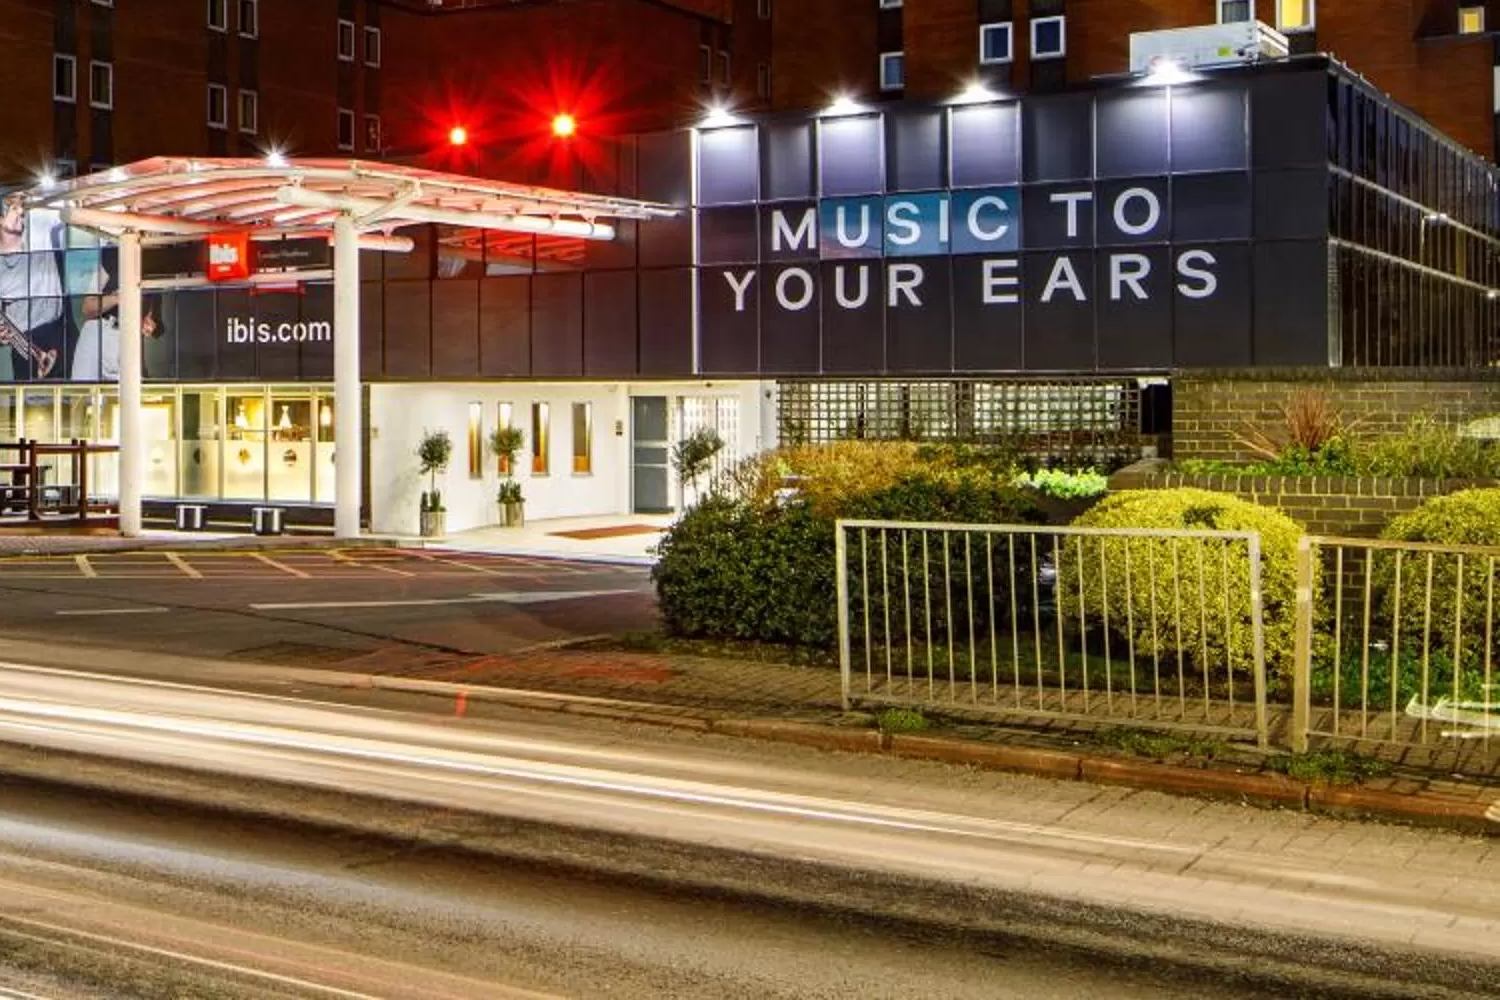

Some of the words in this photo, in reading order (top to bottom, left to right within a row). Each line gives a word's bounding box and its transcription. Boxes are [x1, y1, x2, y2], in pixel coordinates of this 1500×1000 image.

[770, 195, 1009, 252] MUSIC
[1049, 186, 1161, 238] TO
[723, 262, 925, 312] YOUR
[982, 248, 1219, 304] EARS
[227, 316, 331, 343] ibis.com
